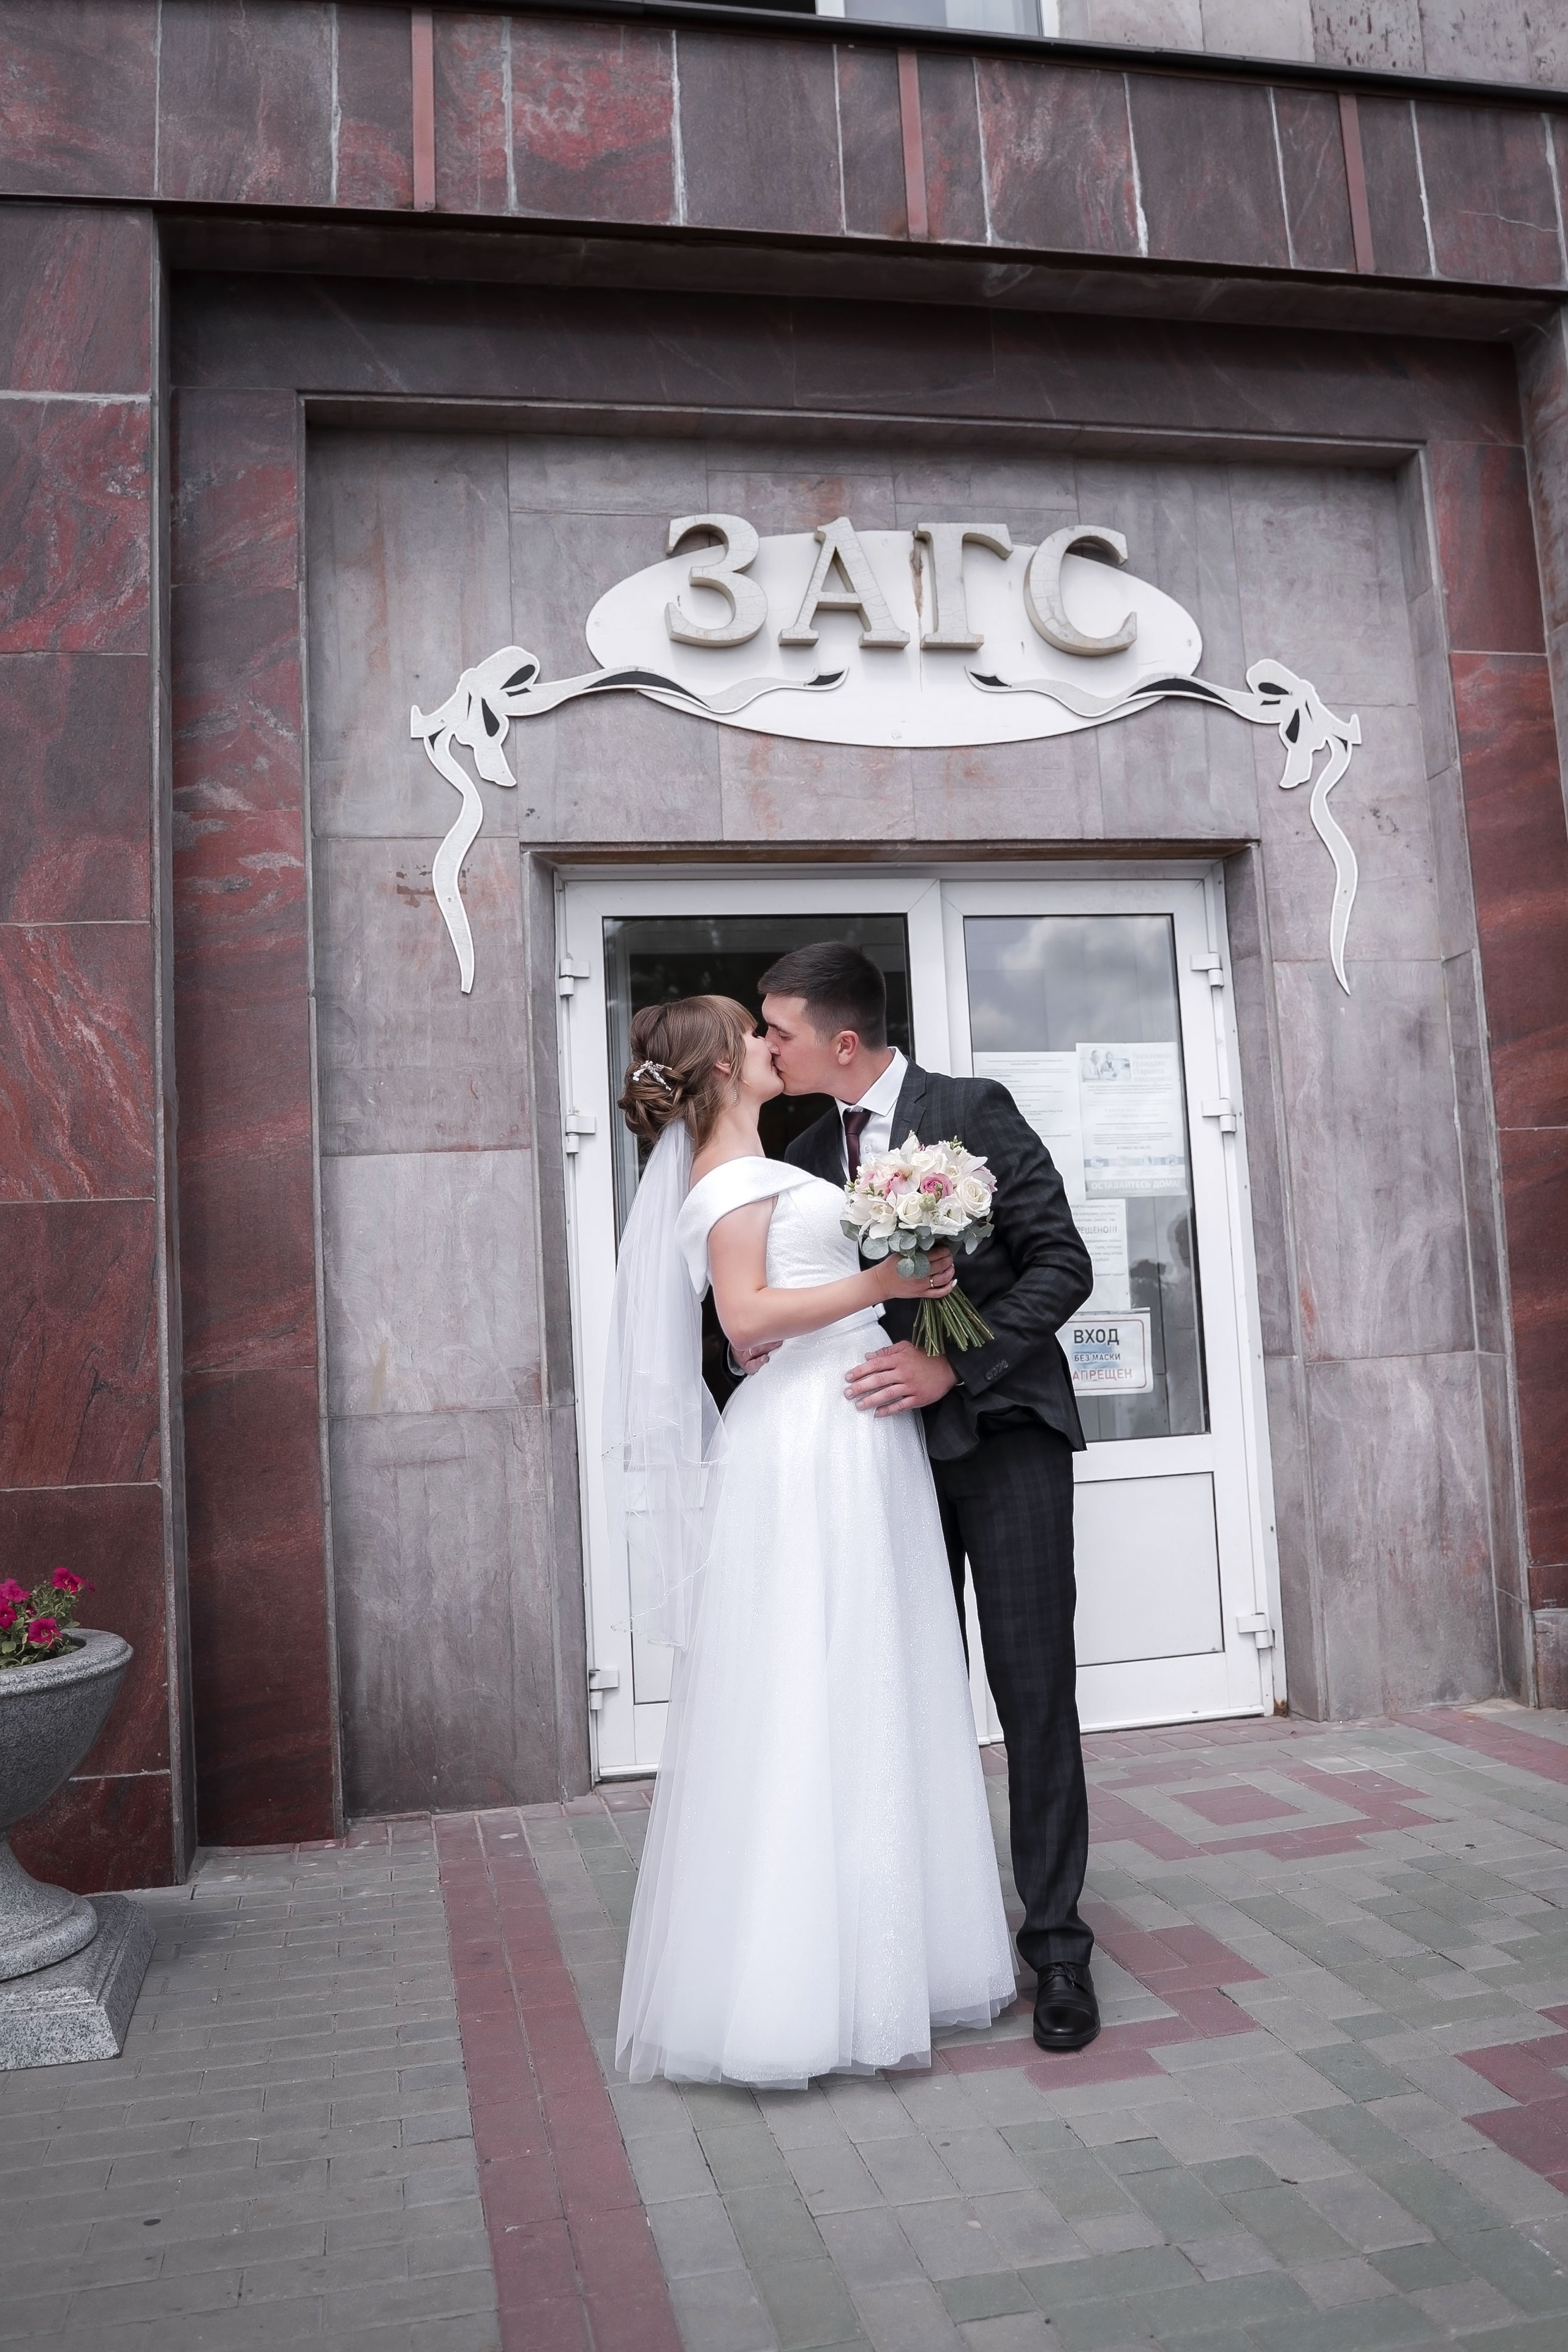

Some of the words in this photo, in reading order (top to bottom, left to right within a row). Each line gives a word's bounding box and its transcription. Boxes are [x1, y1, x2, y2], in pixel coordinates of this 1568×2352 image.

[665, 513, 1137, 656] ЗАГС
[1091, 1180, 1151, 1189] ОСТАВАЙТЕСЬ
[1152, 1180, 1180, 1189] ДОМА!
[1076, 1226, 1118, 1234] РЕЩЕНО!!!
[1074, 1328, 1120, 1346] ВХОД
[1072, 1368, 1133, 1381] АПРЕЩЕН
